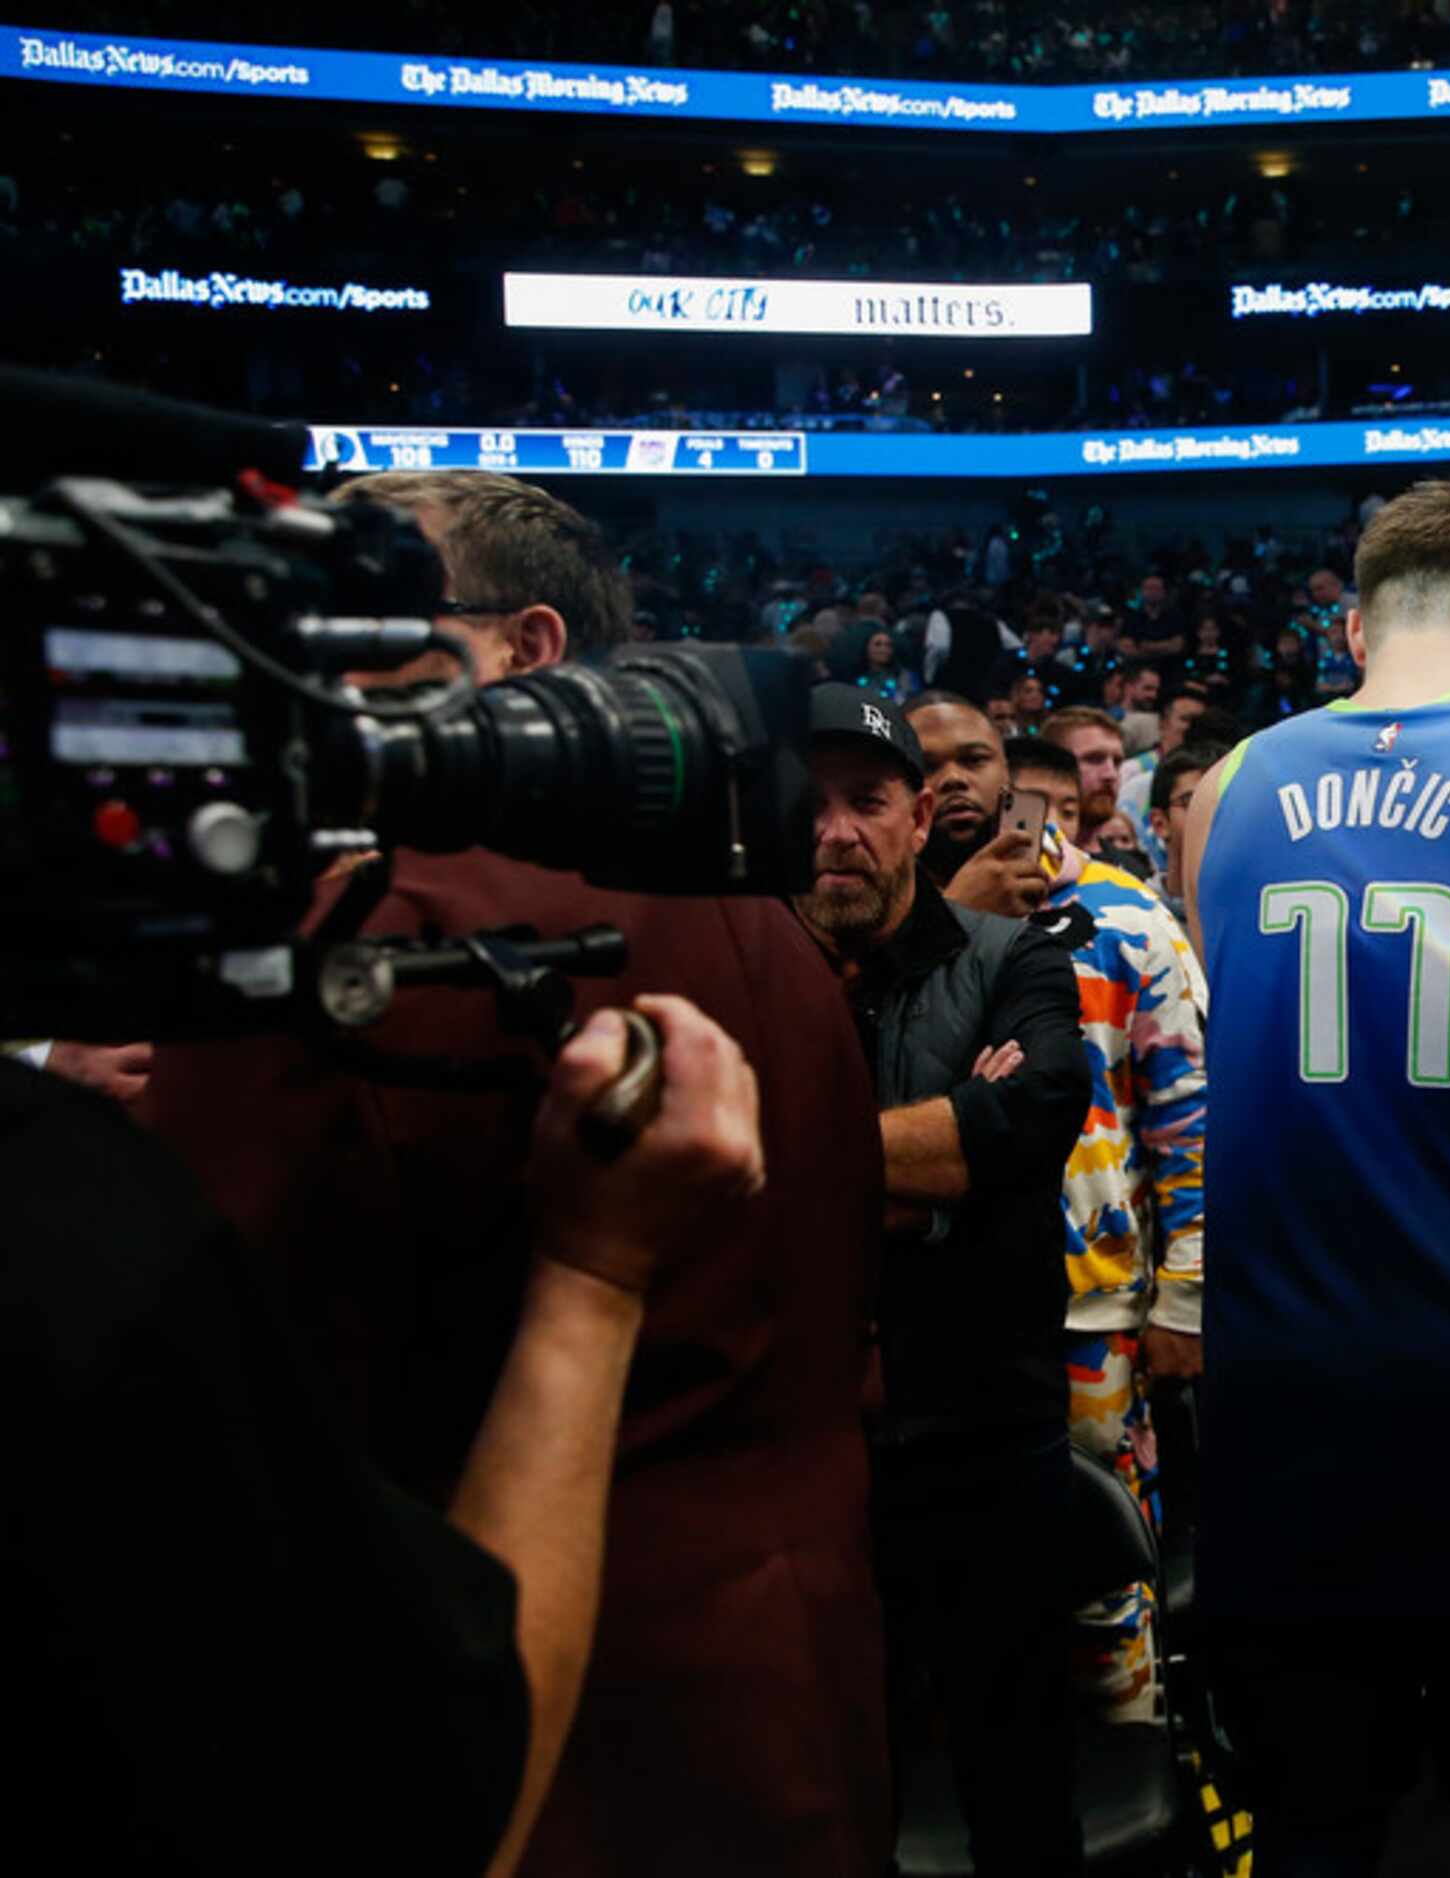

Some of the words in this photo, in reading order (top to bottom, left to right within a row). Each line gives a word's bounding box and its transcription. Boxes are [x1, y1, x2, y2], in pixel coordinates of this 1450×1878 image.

[402, 63, 447, 95] The
[449, 67, 526, 98] Dallas
[523, 70, 624, 105] Morning
[623, 75, 688, 105] News
[1094, 92, 1133, 121] The
[1135, 89, 1202, 118] Dallas
[1201, 85, 1293, 117] Morning
[1292, 84, 1350, 112] News
[853, 296, 1015, 327] matters.
[1083, 441, 1117, 464] The
[1118, 439, 1174, 461] Dallas
[1174, 437, 1251, 461] Morning
[1250, 434, 1299, 458] News
